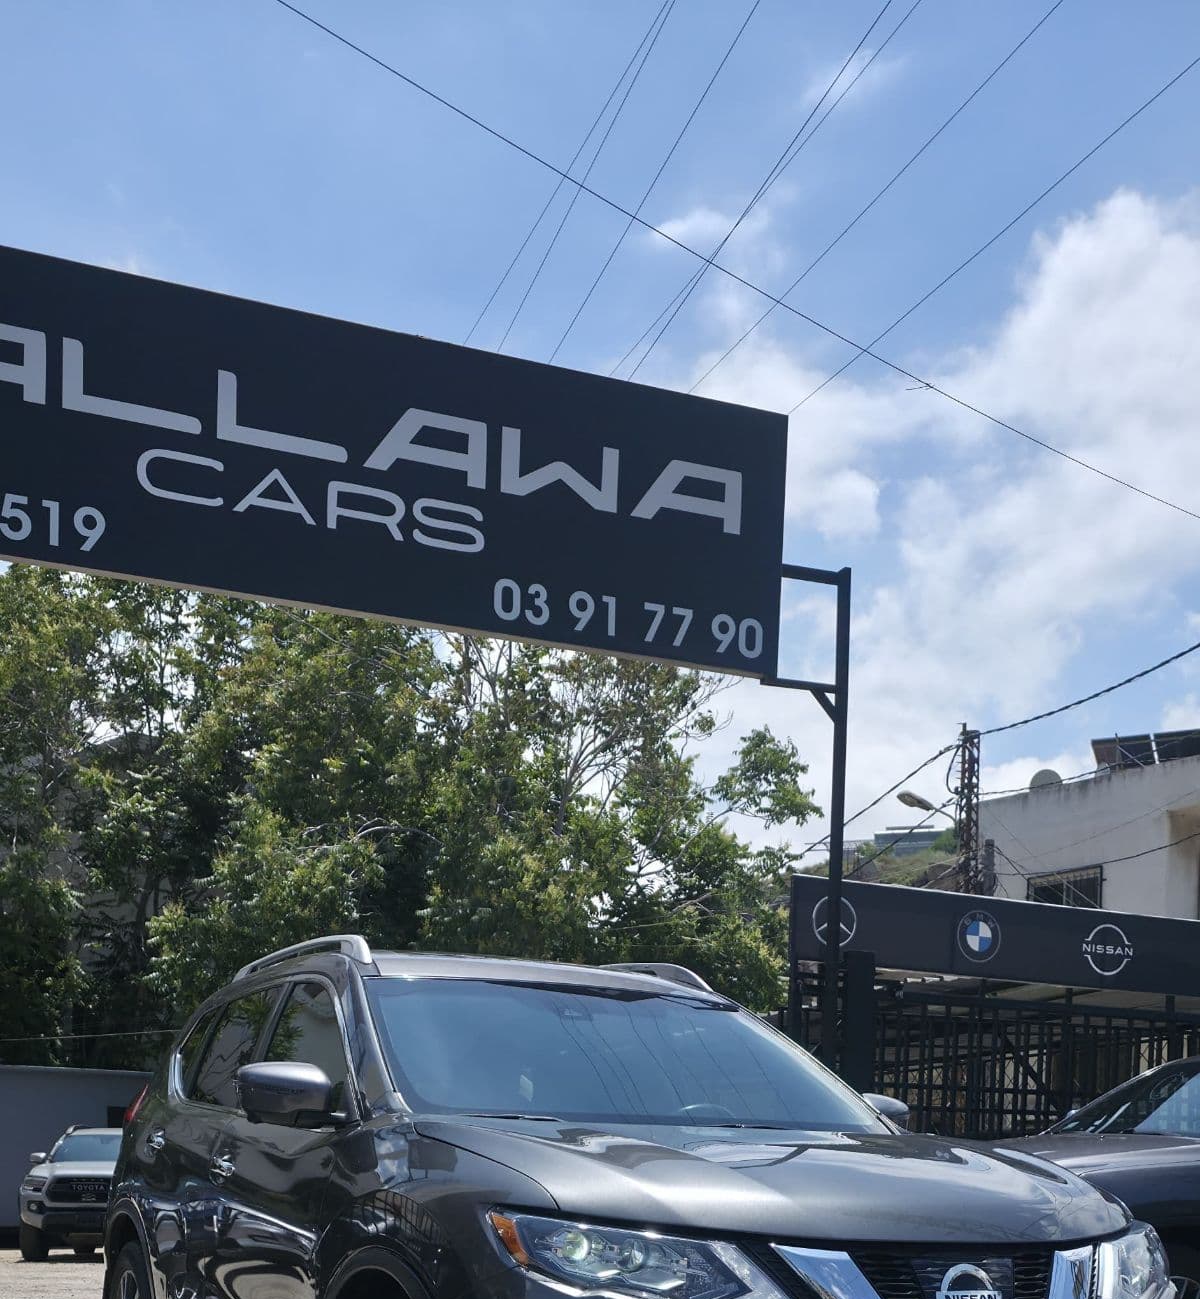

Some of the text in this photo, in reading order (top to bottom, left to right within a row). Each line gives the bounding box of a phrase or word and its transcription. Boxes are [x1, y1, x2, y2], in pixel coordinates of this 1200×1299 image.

[0, 493, 106, 552] 519
[137, 448, 485, 553] CARS
[493, 578, 763, 659] 03 91 77 90
[963, 914, 995, 928] BMW
[1082, 943, 1133, 956] NISSAN
